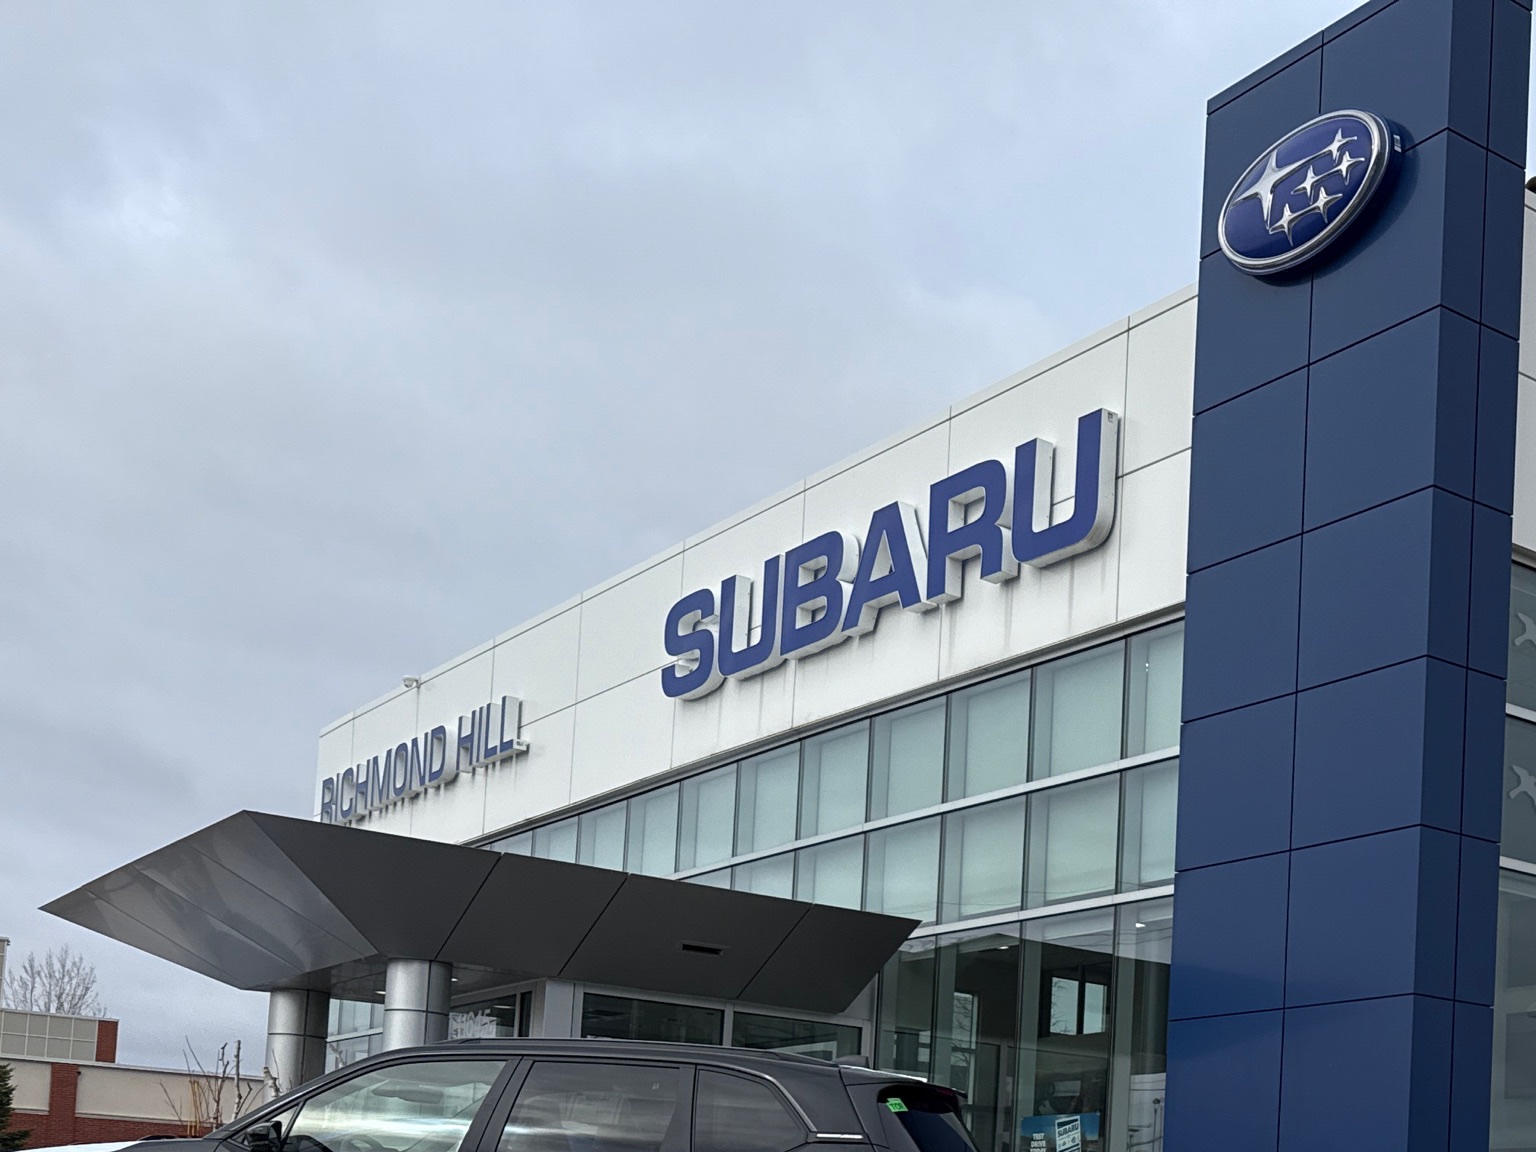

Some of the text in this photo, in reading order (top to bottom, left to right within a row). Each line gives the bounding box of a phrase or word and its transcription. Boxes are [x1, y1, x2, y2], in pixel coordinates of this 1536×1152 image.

[661, 407, 1107, 699] SUBARU
[320, 695, 520, 824] RICHMOND HILL
[1030, 1140, 1047, 1148] DRIVE
[1057, 1122, 1080, 1138] SUBARU
